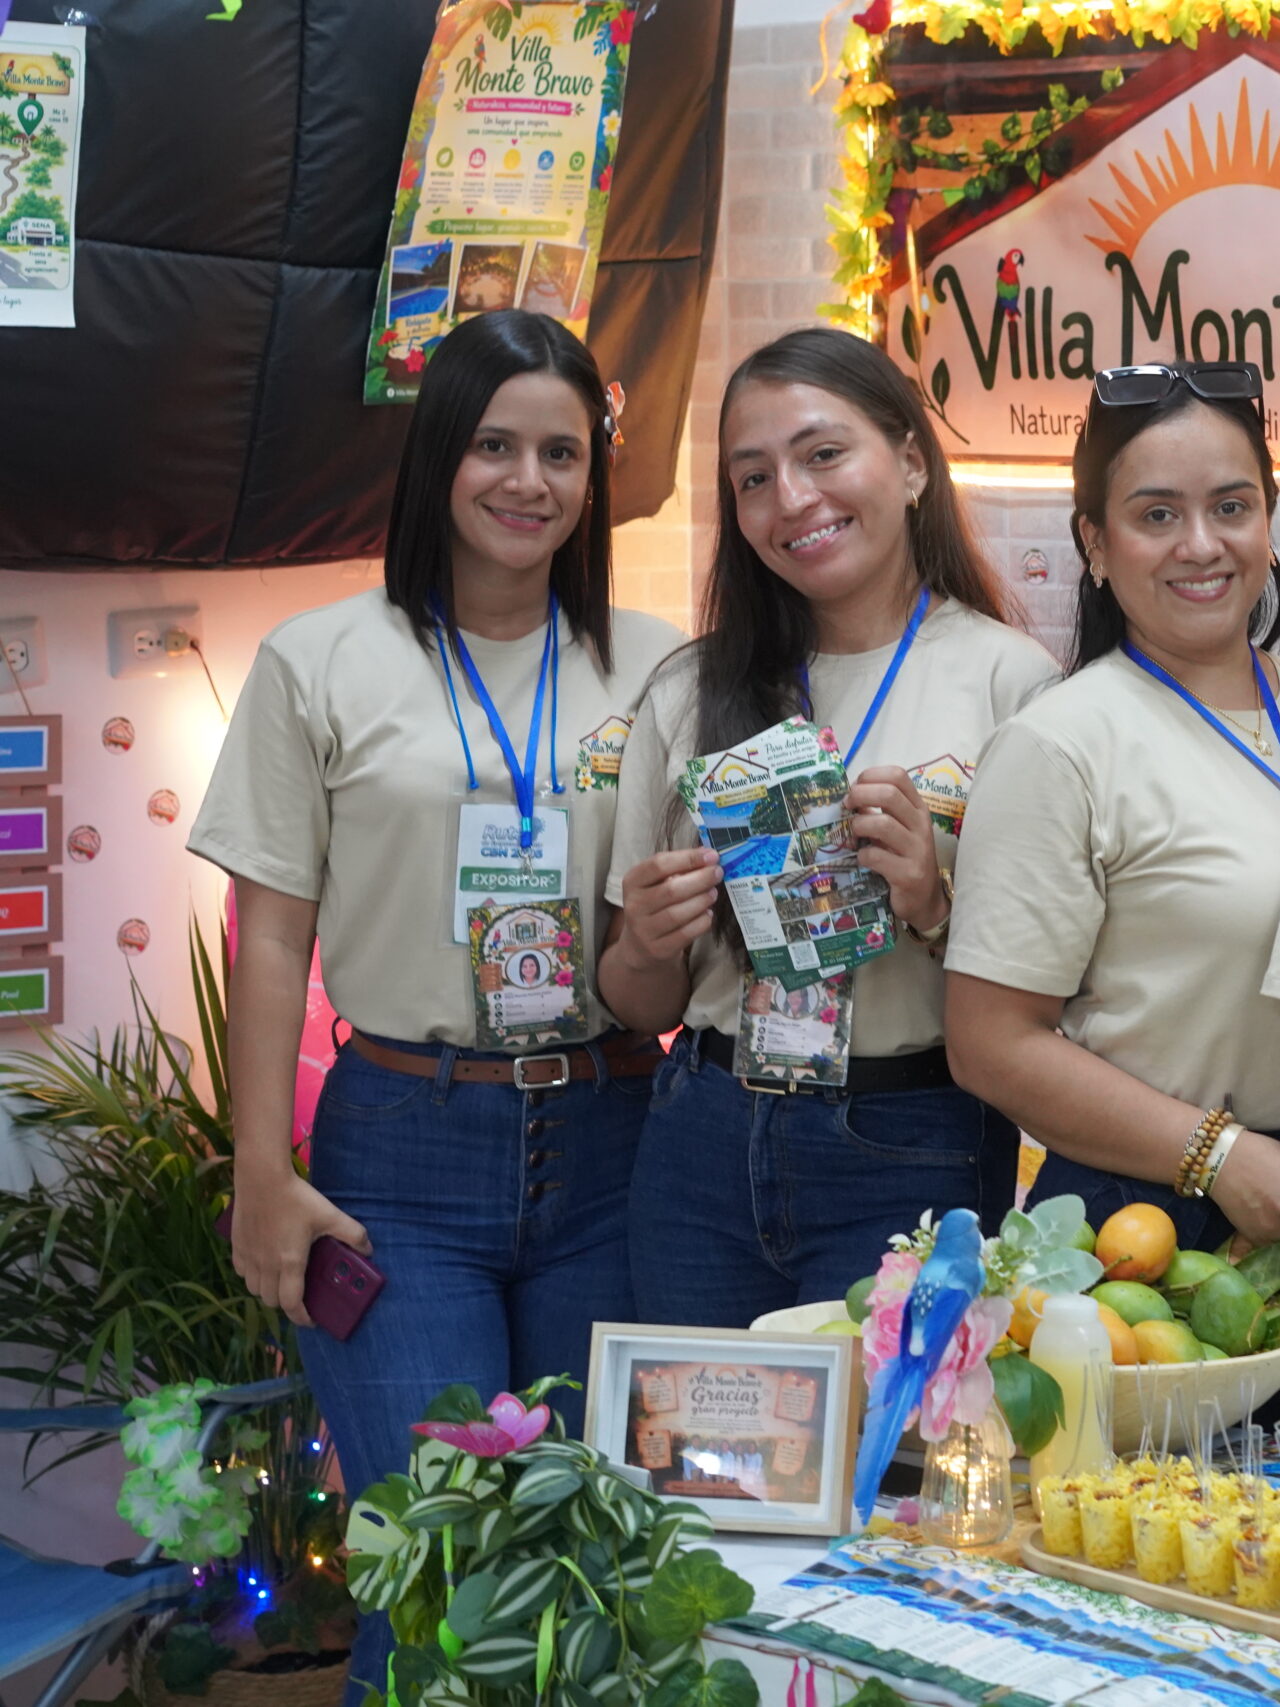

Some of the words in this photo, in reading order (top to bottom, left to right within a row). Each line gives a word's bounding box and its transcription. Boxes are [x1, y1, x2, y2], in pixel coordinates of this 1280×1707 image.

[511, 36, 551, 62] Villa
[23, 74, 44, 85] Monte
[47, 76, 65, 86] Bravo
[454, 56, 525, 94] Monte
[533, 61, 594, 96] Bravo
[507, 102, 541, 111] comunidad
[483, 115, 492, 124] Un
[495, 116, 512, 127] lugar
[514, 118, 525, 127] que
[482, 127, 517, 136] comunidad
[519, 129, 530, 138] que
[933, 264, 1095, 390] Villa
[1010, 404, 1090, 437] Natura
[583, 741, 604, 754] Villa
[705, 780, 724, 795] Villa
[724, 776, 749, 791] Monte
[748, 772, 770, 786] Bravo
[924, 778, 953, 796] Monte
[481, 847, 508, 858] CBN
[472, 873, 548, 888] EXPOSITOR
[1, 990, 19, 999] Pool
[694, 1373, 714, 1386] Villa
[715, 1375, 737, 1386] Monte
[738, 1376, 758, 1387] Bravo
[691, 1386, 760, 1405] Gracias
[691, 1406, 716, 1417] gran
[718, 1406, 759, 1418] proyecto
